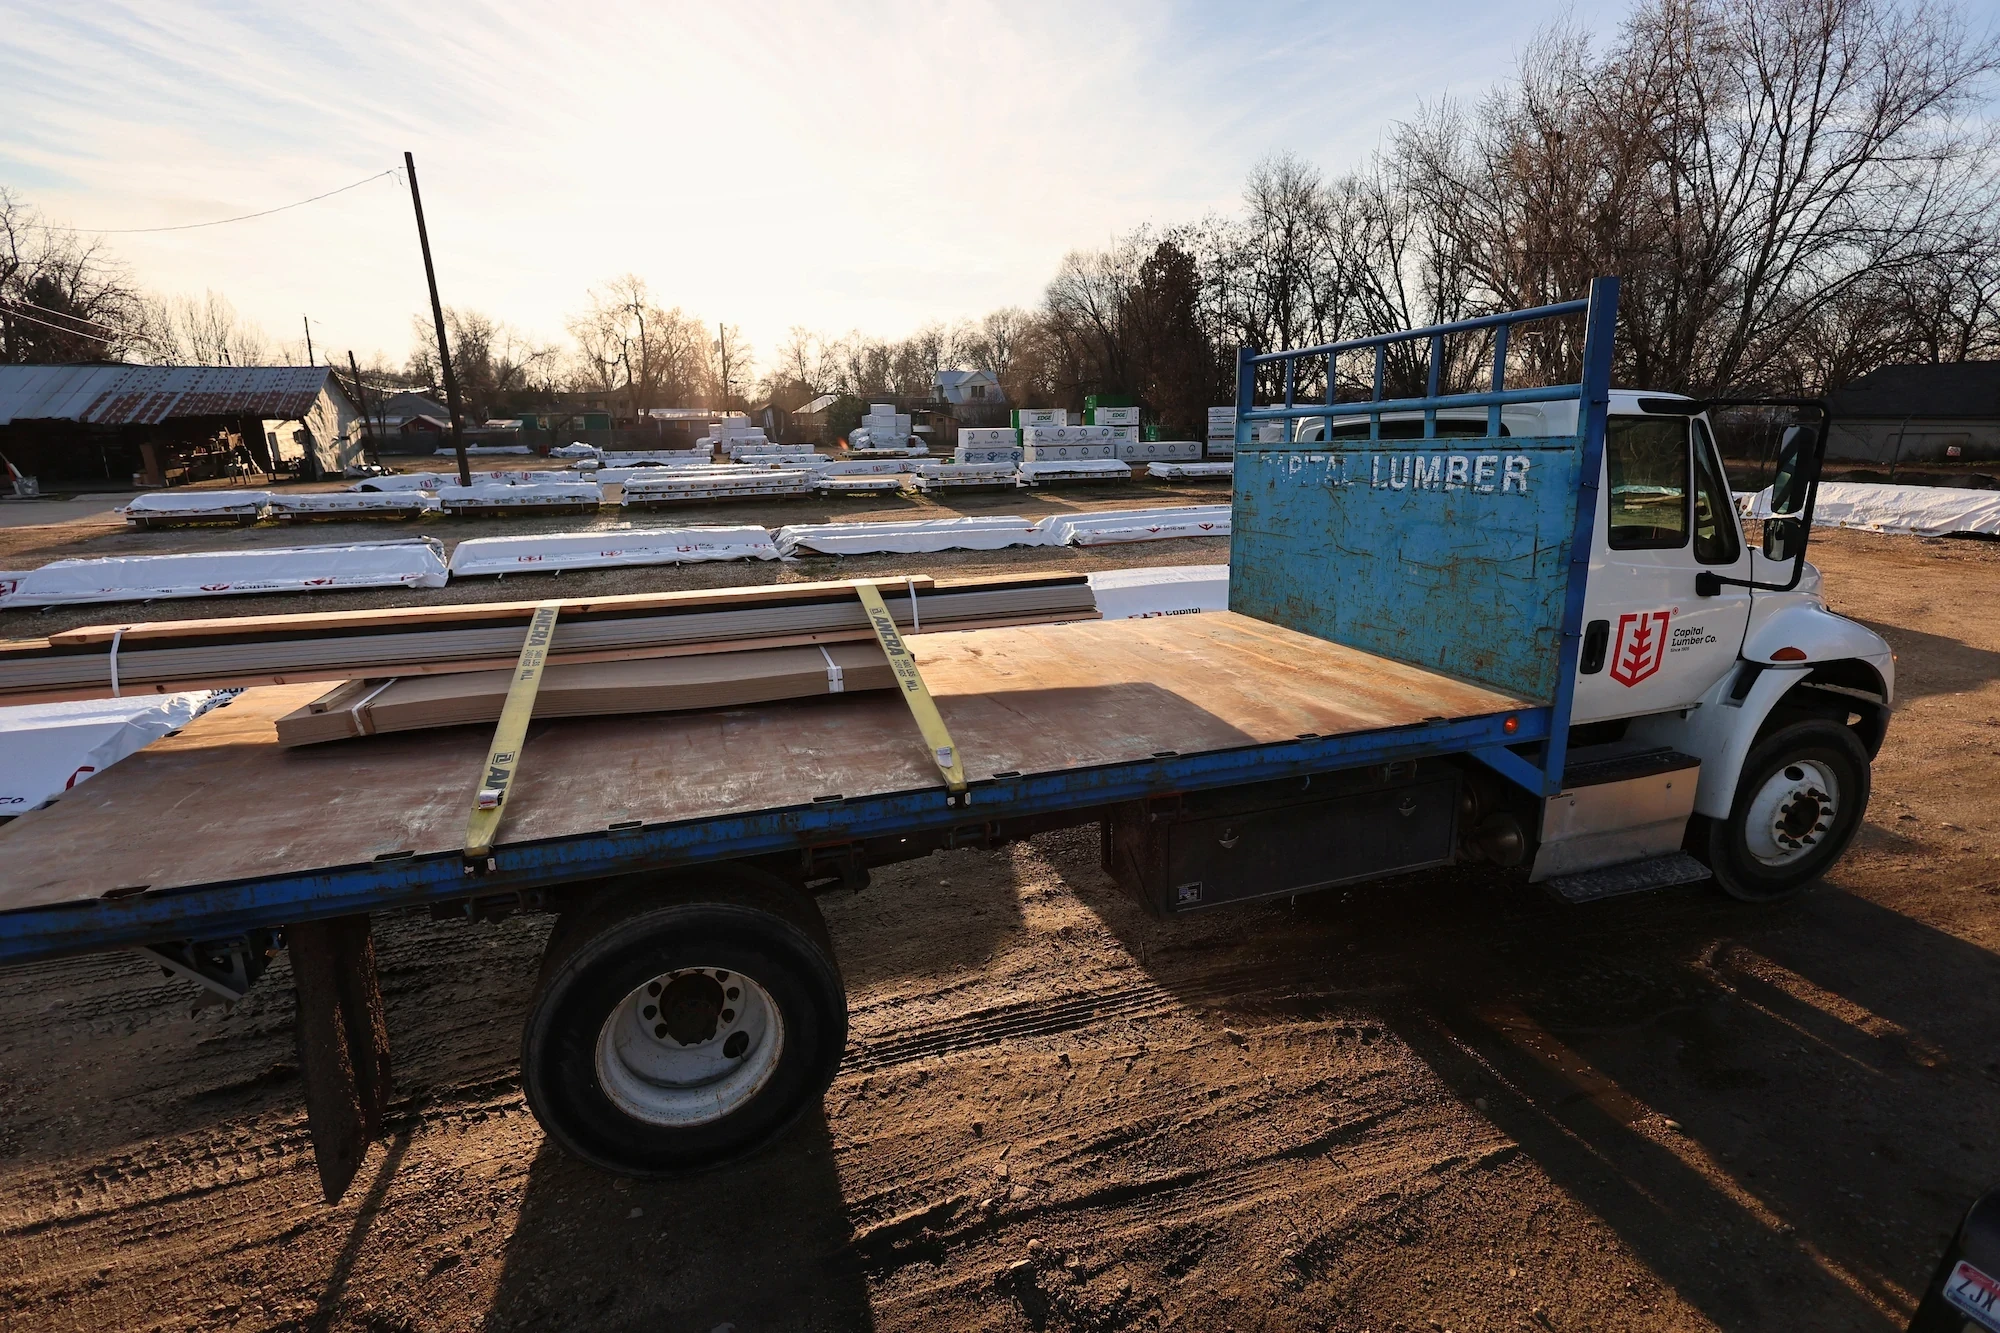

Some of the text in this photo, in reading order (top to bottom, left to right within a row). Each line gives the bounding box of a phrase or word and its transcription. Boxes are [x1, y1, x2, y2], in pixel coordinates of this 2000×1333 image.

[1370, 455, 1531, 493] LUMBER
[1674, 627, 1704, 638] Capital
[1671, 635, 1717, 646] Lumber Co.
